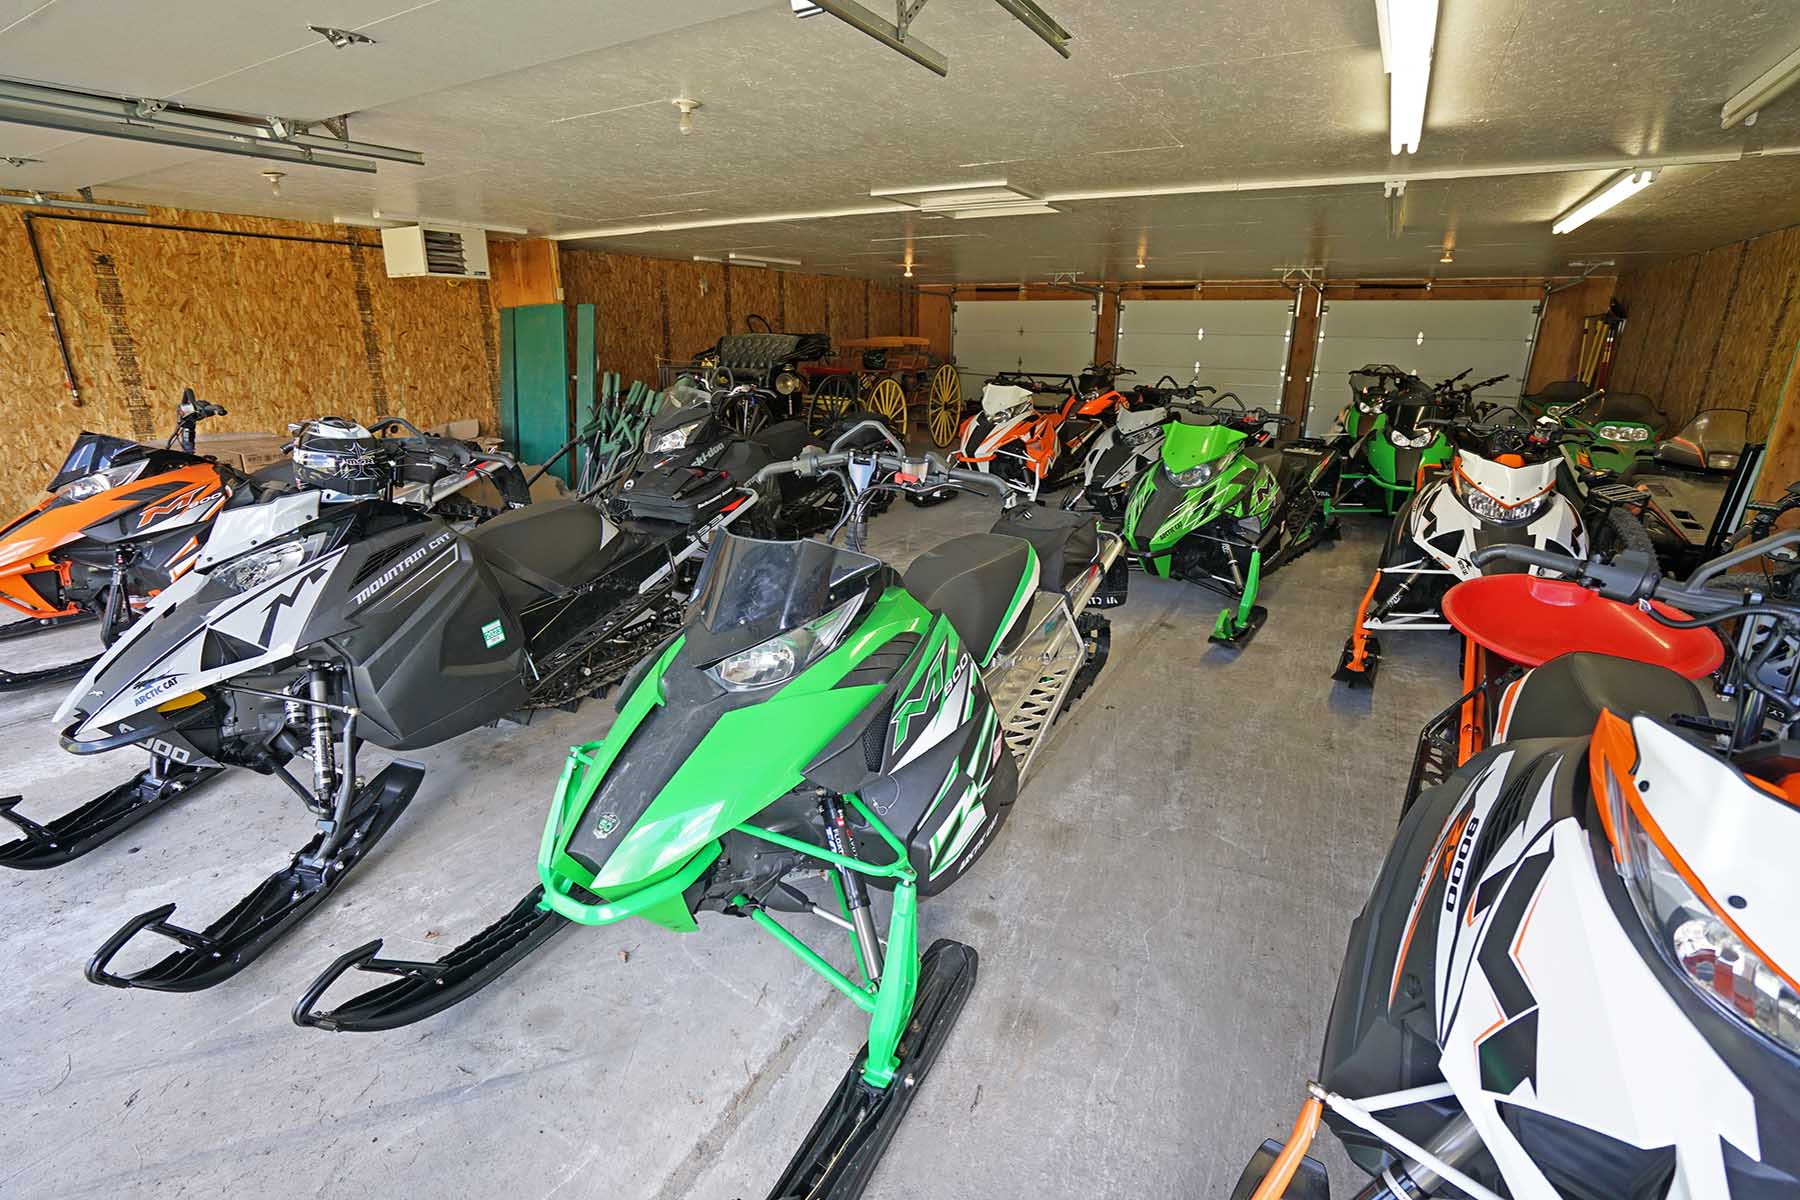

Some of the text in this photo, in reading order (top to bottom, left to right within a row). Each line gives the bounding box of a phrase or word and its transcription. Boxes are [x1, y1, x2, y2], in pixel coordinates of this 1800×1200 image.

[346, 532, 451, 605] MOUNTAIN CAT
[134, 677, 179, 706] ARCTIC CAT
[944, 652, 968, 697] 800
[1445, 817, 1479, 912] 8000
